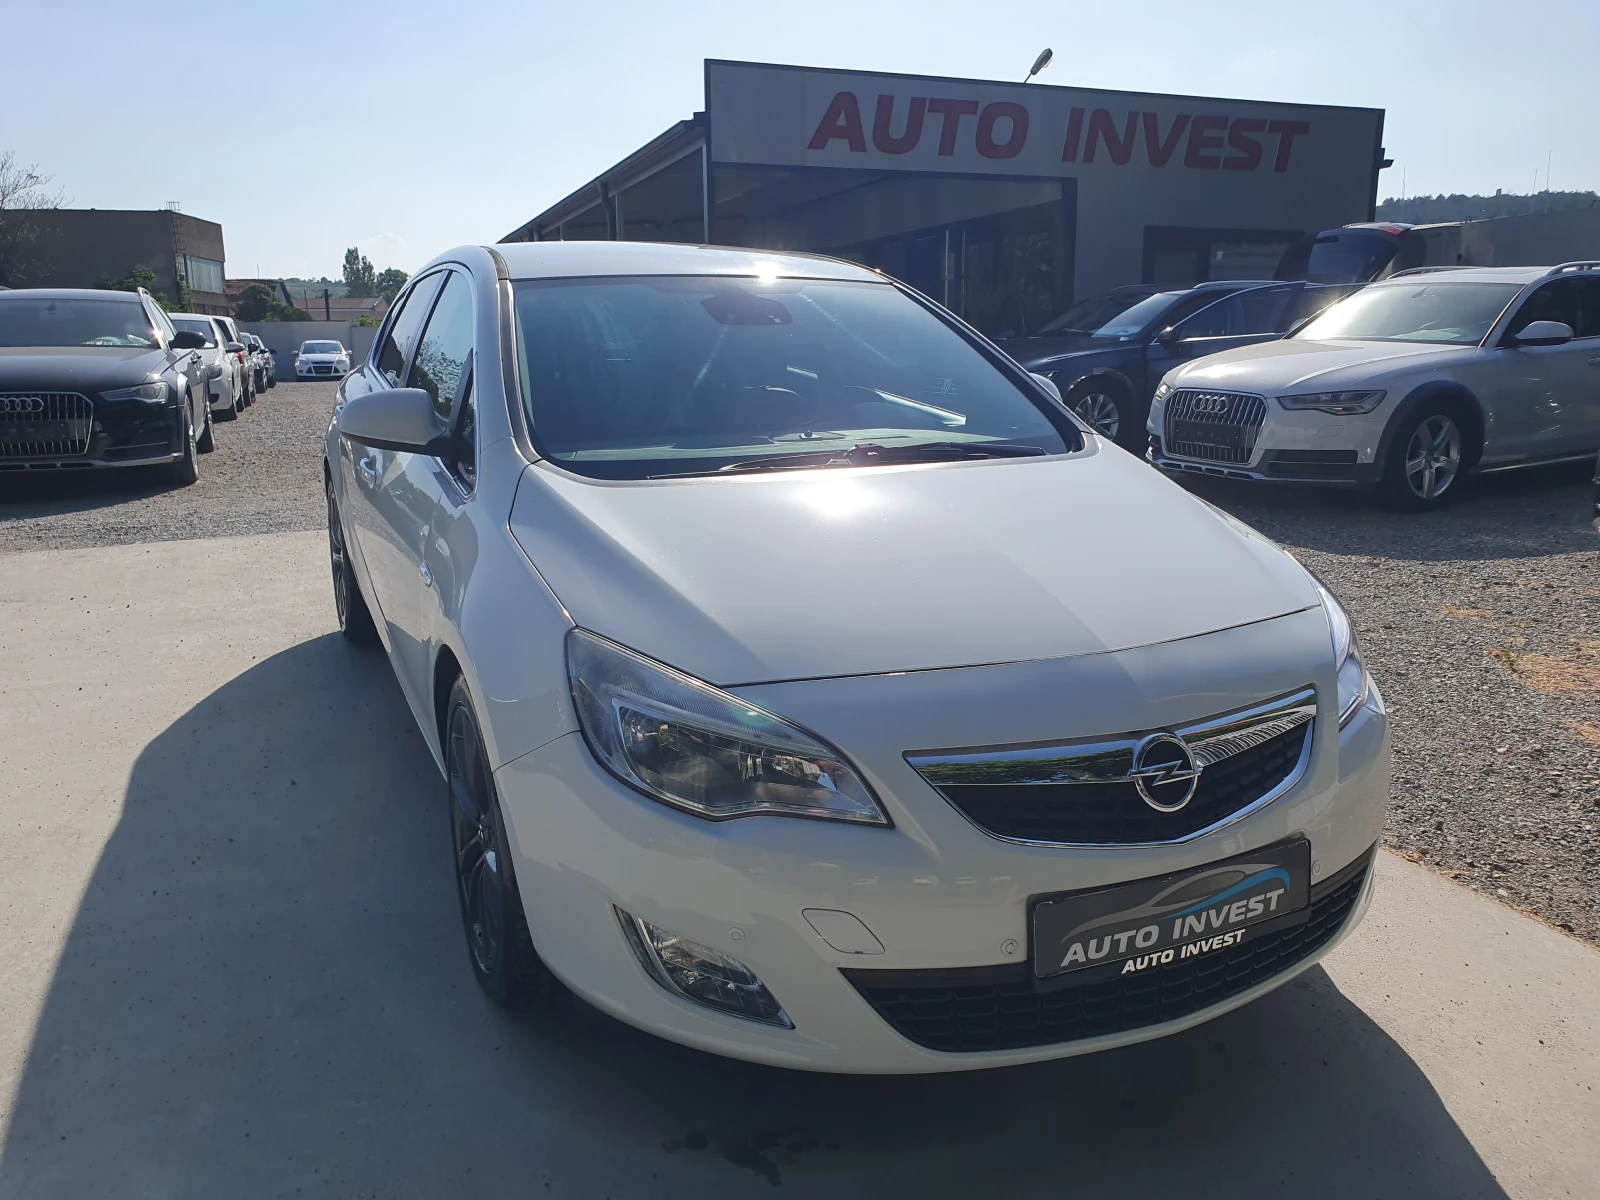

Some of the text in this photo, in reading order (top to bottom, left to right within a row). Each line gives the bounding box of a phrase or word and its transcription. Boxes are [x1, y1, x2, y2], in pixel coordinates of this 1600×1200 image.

[807, 91, 1310, 173] AUTO INVEST
[1060, 888, 1285, 967] AUTO INVEST
[1121, 929, 1246, 974] AUTO INVEST
